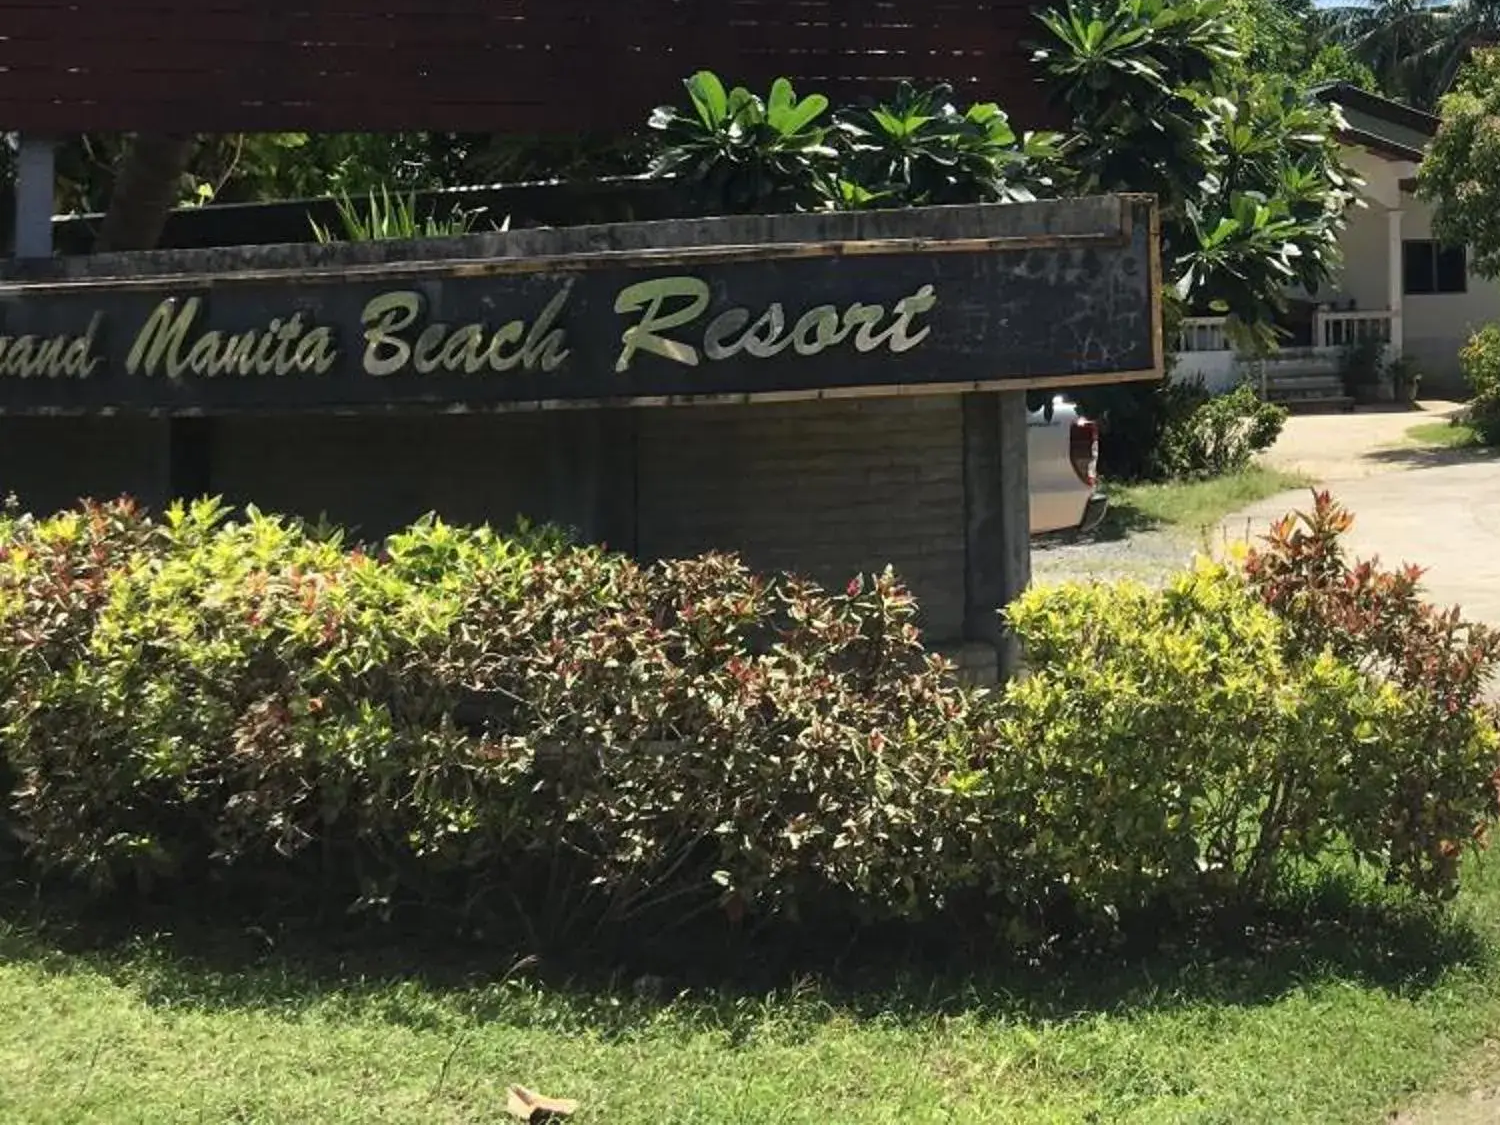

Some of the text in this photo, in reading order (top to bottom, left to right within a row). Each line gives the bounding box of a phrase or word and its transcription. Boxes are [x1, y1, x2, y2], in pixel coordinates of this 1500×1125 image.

[126, 296, 338, 378] Manita
[360, 290, 570, 377] Beach
[613, 276, 938, 374] Resort
